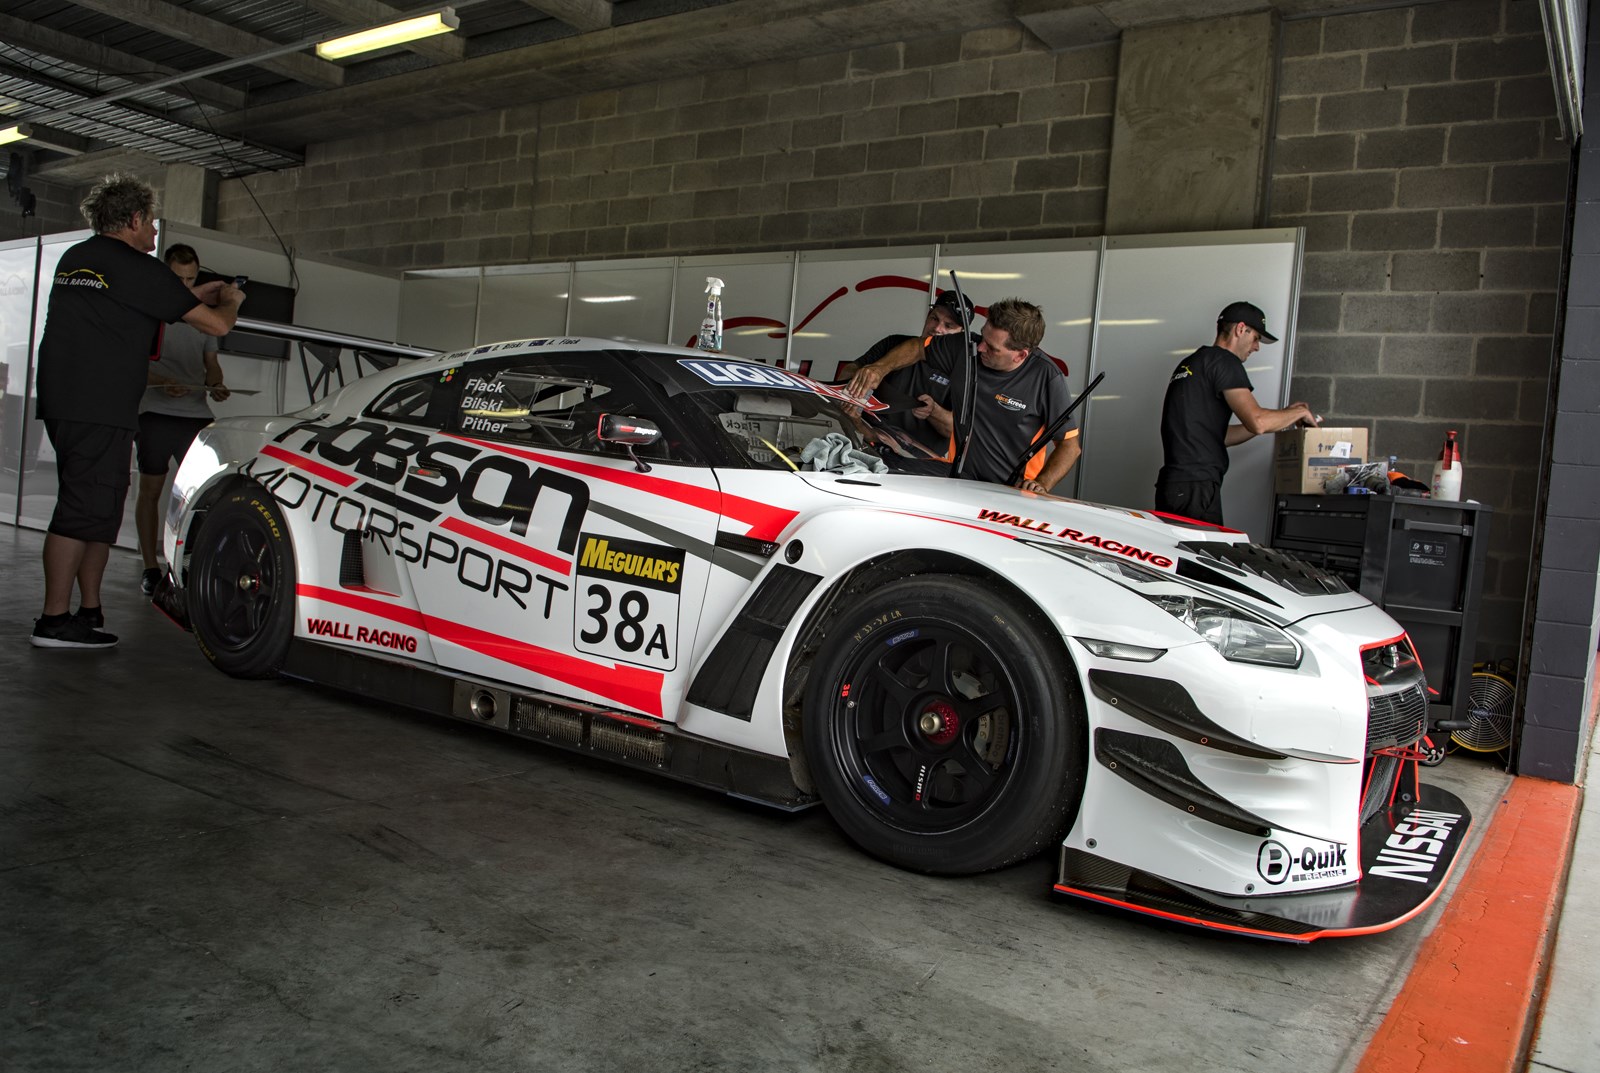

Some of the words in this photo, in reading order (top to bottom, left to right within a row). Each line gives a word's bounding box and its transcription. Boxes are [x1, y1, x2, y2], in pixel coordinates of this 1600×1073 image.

[69, 278, 103, 289] RACING
[688, 362, 807, 390] LIQUI
[464, 378, 506, 394] Flack
[460, 396, 504, 412] Bilski
[461, 416, 508, 434] Pither
[238, 456, 570, 620] MOTORSPORT
[976, 508, 1055, 535] WALL
[1057, 528, 1174, 569] RACING
[307, 617, 354, 641] WALL
[356, 625, 418, 653] RACING
[842, 683, 851, 698] 38
[1368, 808, 1463, 884] NISSAN
[1305, 869, 1345, 882] RACING
